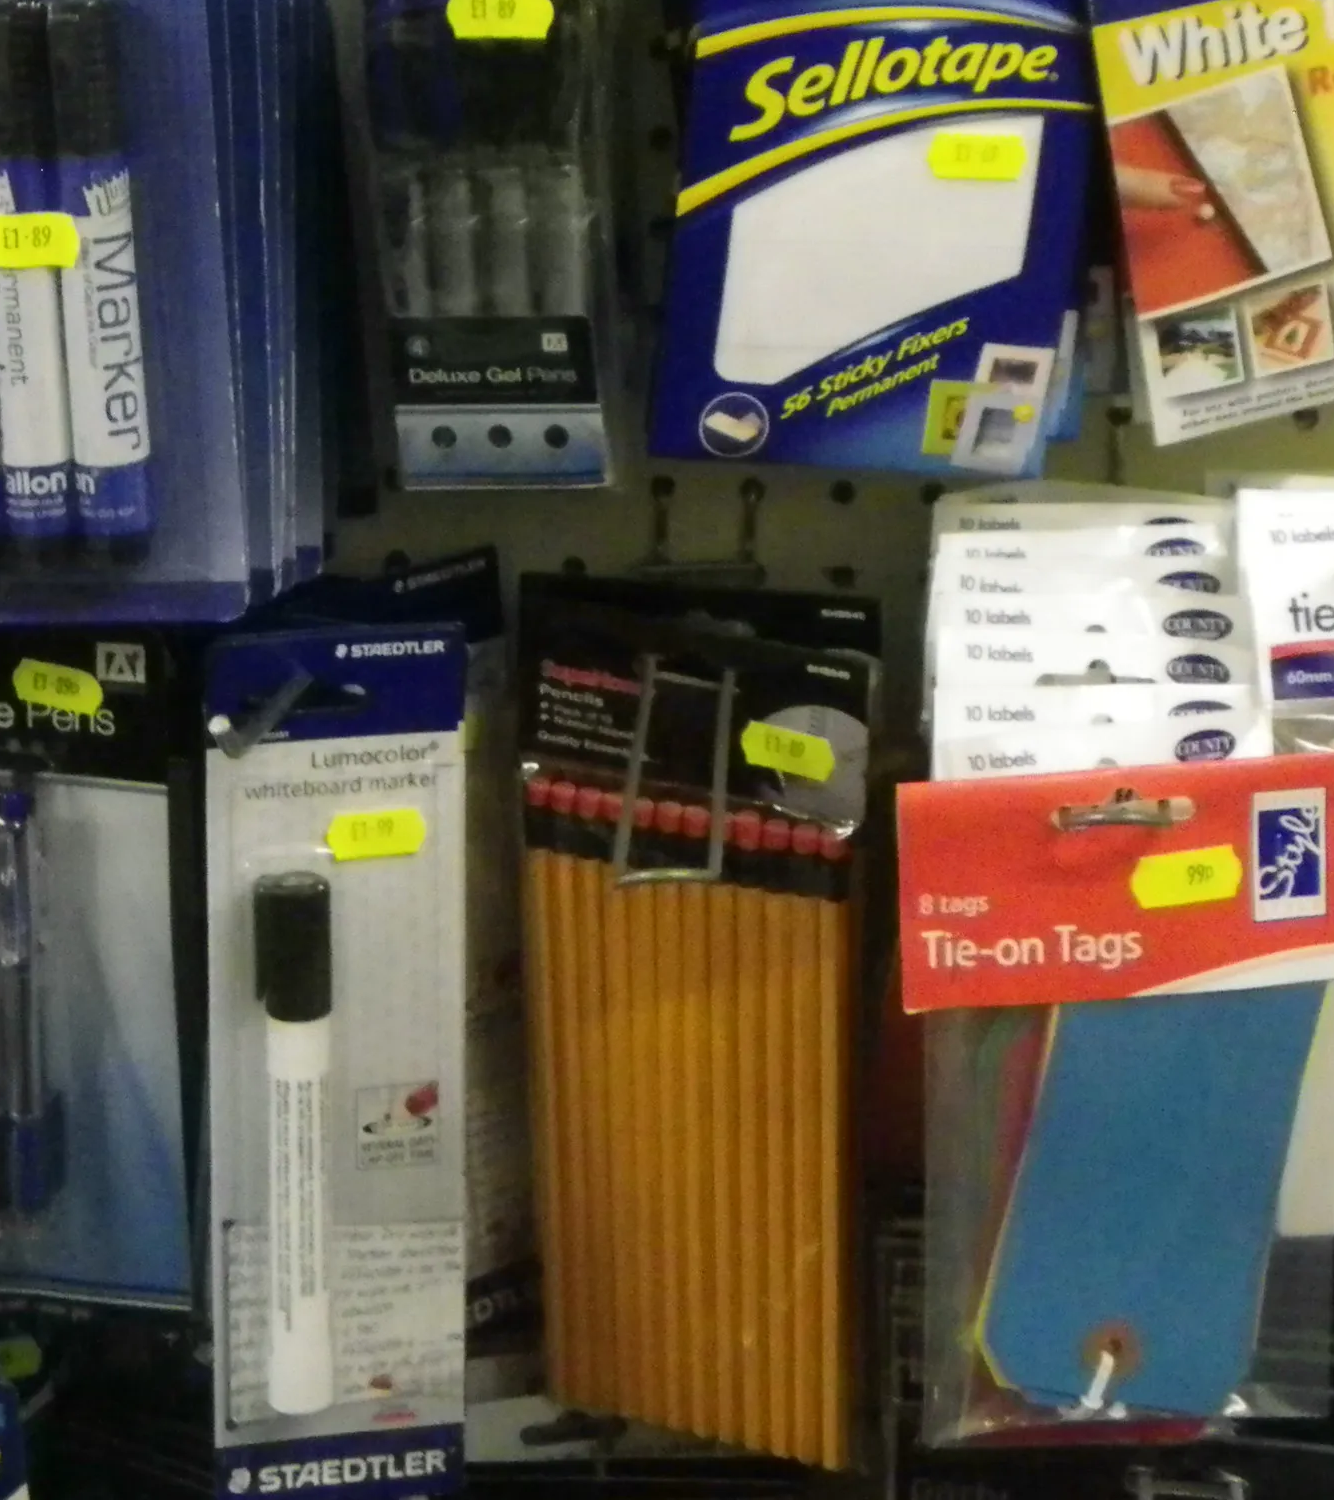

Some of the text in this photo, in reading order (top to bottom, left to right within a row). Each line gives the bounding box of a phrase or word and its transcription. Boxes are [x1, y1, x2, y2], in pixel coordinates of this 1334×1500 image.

[1117, 0, 1309, 86] White
[729, 35, 1059, 143] Sellotape
[3, 268, 29, 386] rmanent
[92, 230, 142, 450] Marker
[409, 367, 577, 384] Deluxe Gel Pens
[780, 316, 971, 420] 56 Sticky Fixers
[825, 353, 941, 418] Permanent
[965, 610, 1031, 624] 10 labels
[351, 640, 445, 658] STAEDTLER
[967, 646, 1034, 662] 10 labels
[965, 706, 1035, 722] 10 labels
[968, 753, 1037, 771] 10 labels
[244, 772, 438, 800] whiteboard marker
[1258, 804, 1321, 901] Style
[919, 895, 989, 918] 8 tags
[921, 923, 1143, 969] Tie-on Tags
[258, 1449, 447, 1493] STAEDTLER
